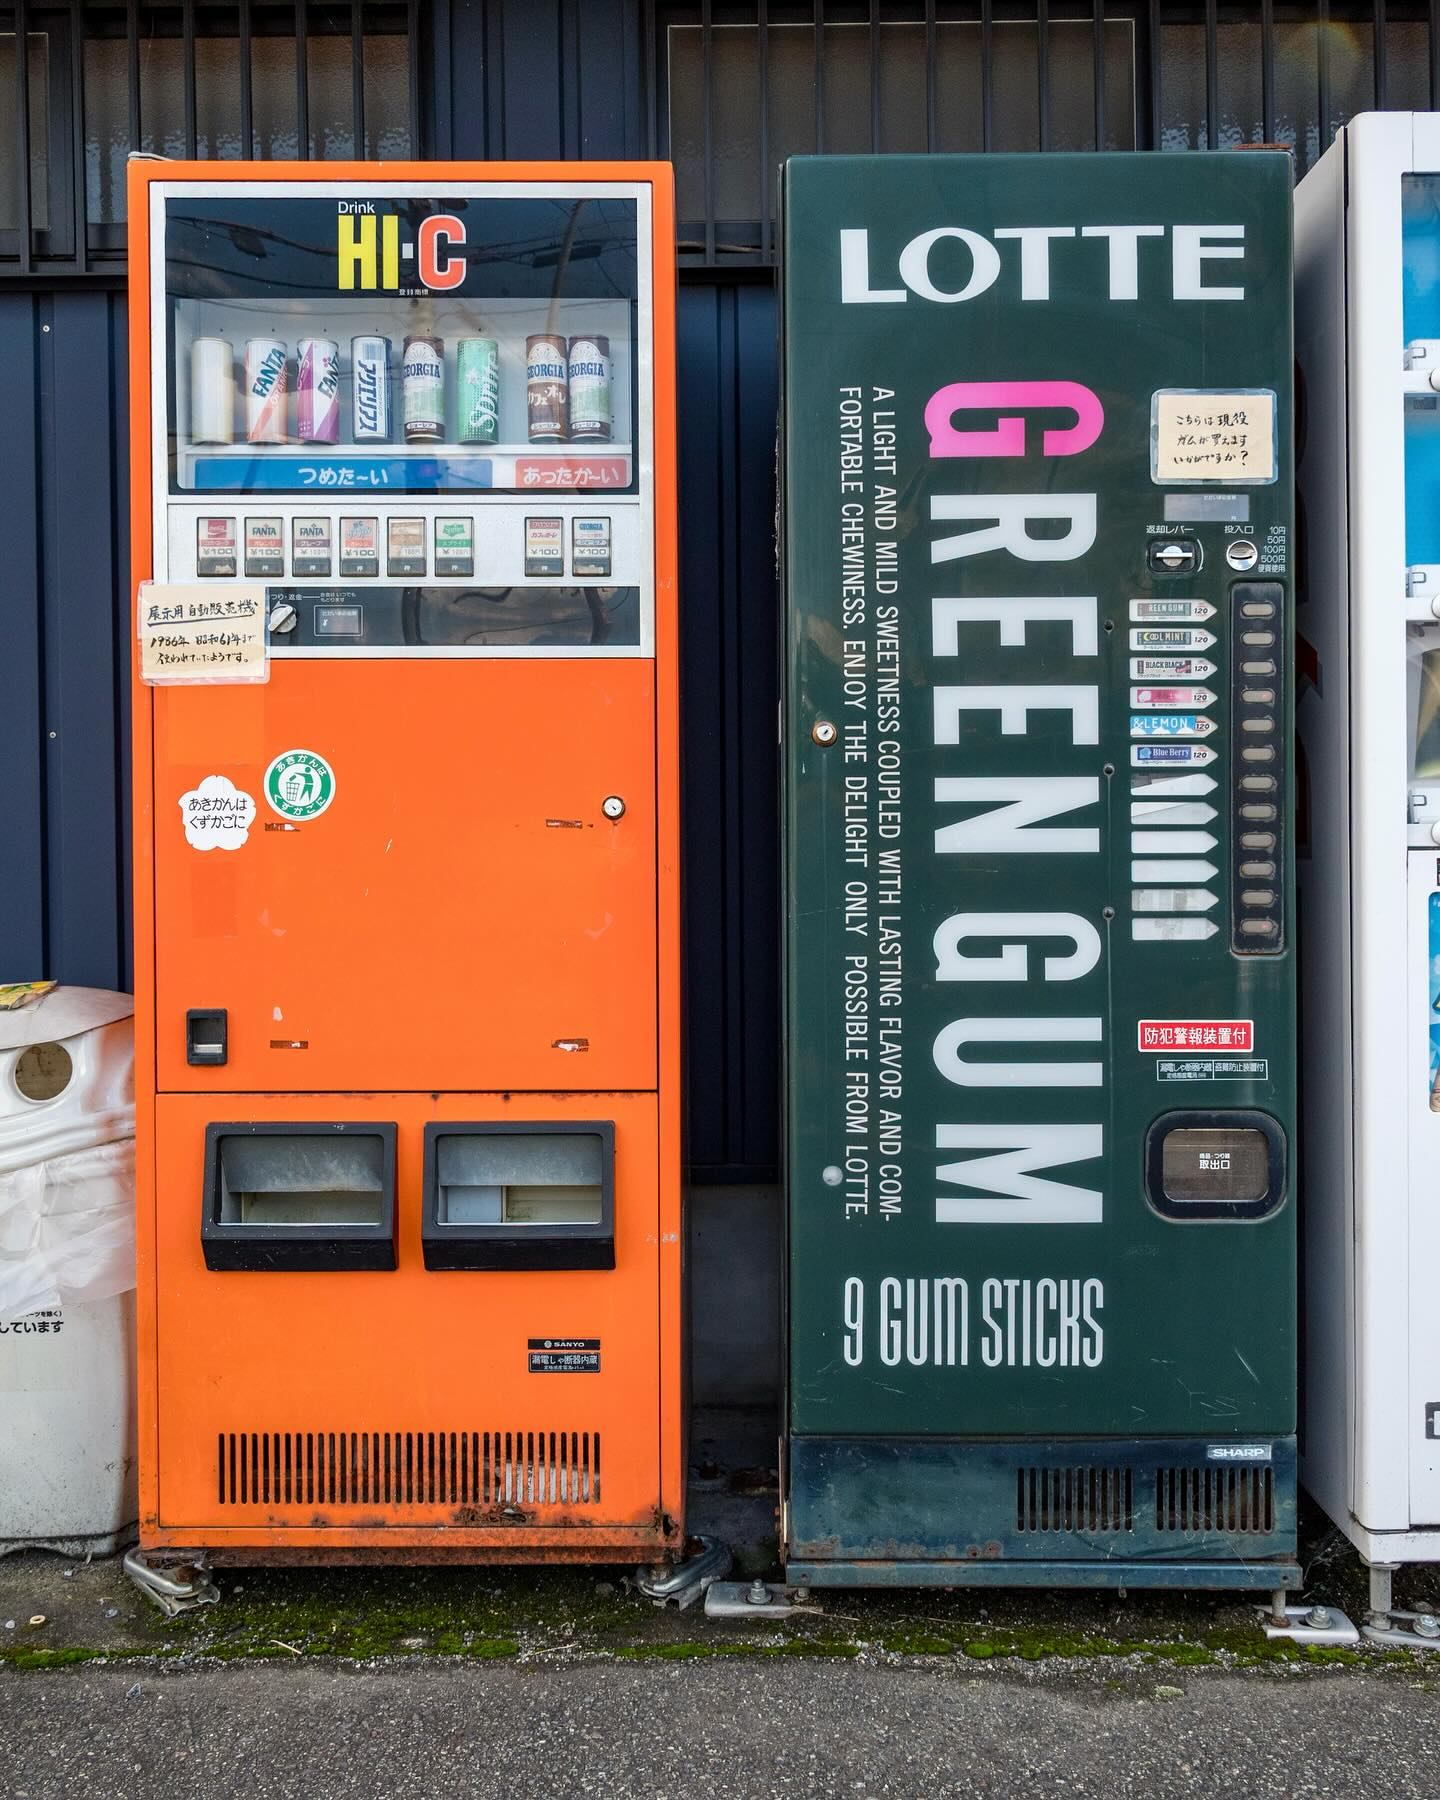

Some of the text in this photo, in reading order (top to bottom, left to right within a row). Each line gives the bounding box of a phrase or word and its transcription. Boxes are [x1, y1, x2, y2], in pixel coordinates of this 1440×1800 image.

[338, 201, 375, 214] Drink
[840, 224, 1245, 304] LOTTE
[252, 348, 286, 398] FANTA
[318, 353, 339, 399] FANT
[358, 359, 377, 432] アクエリアス
[252, 527, 277, 536] FANTA
[300, 527, 324, 536] FANTA
[1146, 525, 1194, 534] 返却レバー
[1224, 525, 1254, 534] 投入口
[1269, 526, 1286, 534] 10円
[1266, 536, 1286, 544] 50円
[250, 548, 281, 556] ¥100
[1264, 546, 1286, 554] 100円
[1260, 554, 1286, 563] 500円
[1168, 604, 1184, 612] GUM
[1143, 632, 1164, 641] COOL
[1165, 632, 1184, 640] MINT
[1152, 748, 1190, 758] Blue Berry
[188, 798, 248, 812] あきかんは
[840, 387, 868, 1219] FORTABLE CHEWINESS. ENJOY THE DELIGHT ONLY POSSIBLE FROM LOTTE.
[873, 387, 901, 1221] A LIGHT AND MILD SWEETNESS COUPLED WITH LASTING FLAVOR AND COM-
[924, 381, 1105, 1223] GREEN GUM
[190, 814, 246, 829] くずかごに
[1144, 1027, 1247, 1045] 防犯警報装置付
[1199, 1160, 1230, 1170] 取出口
[0, 1320, 64, 1334] しています
[844, 1276, 1104, 1368] 9 GUM STICKS
[1212, 1448, 1264, 1457] SHARP
